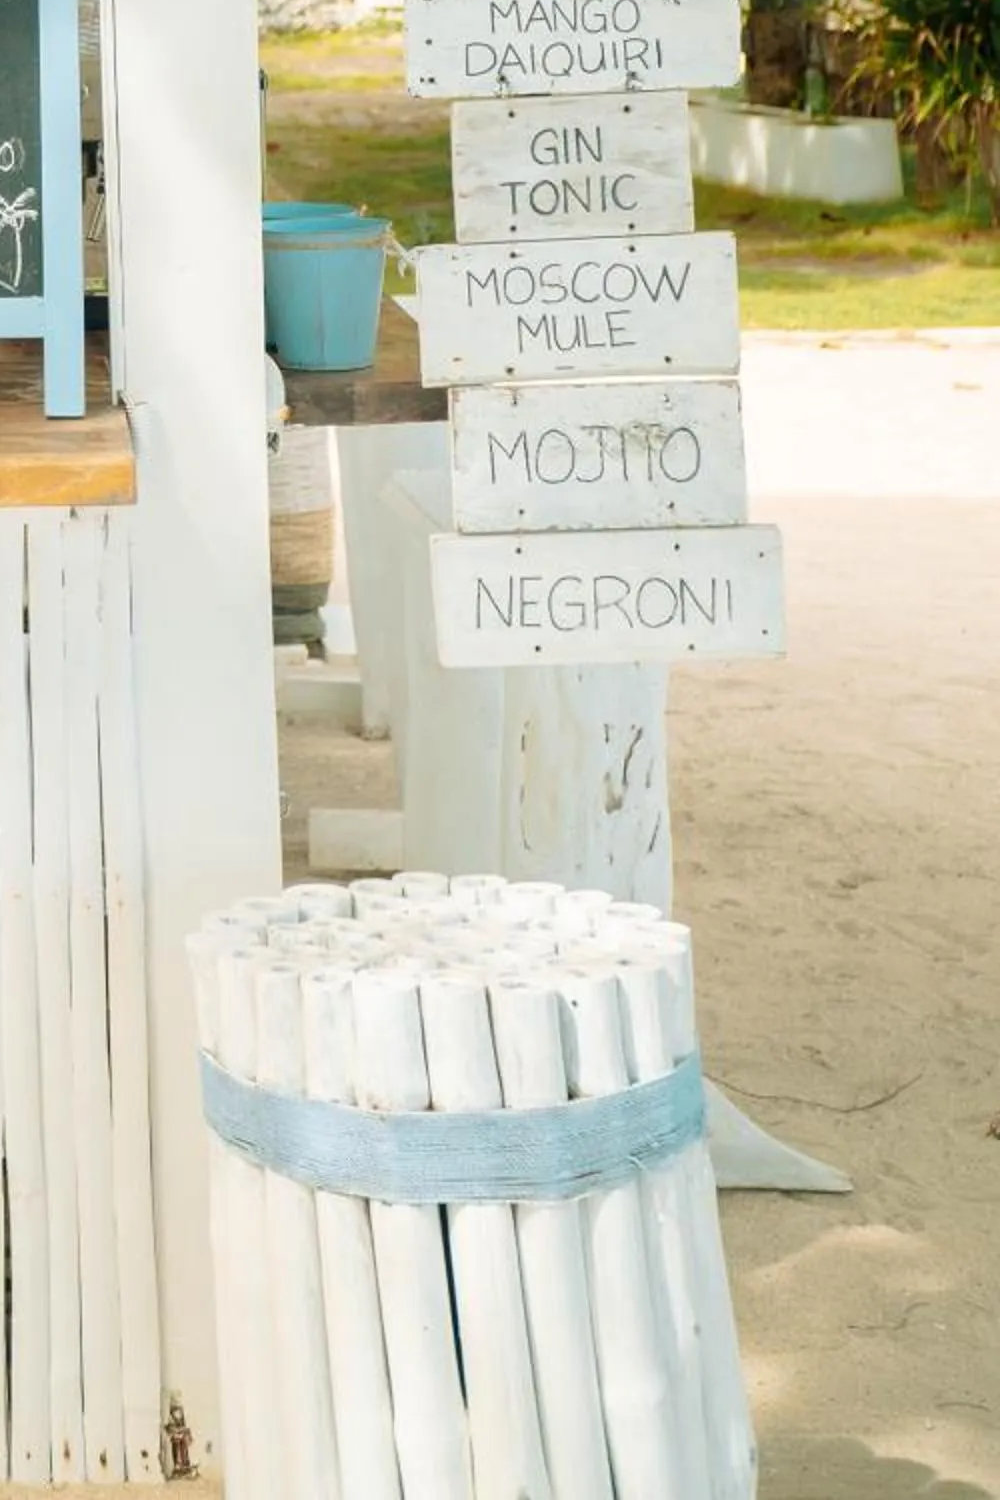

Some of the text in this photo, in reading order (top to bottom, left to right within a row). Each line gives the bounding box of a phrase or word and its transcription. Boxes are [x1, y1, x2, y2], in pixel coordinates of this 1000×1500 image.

[464, 38, 664, 77] DAIQUIRI
[530, 126, 603, 166] GIN
[501, 173, 638, 216] TONIC
[465, 261, 692, 307] MOSCOW
[516, 310, 637, 353] MULE
[487, 423, 701, 485] MOJITO
[474, 574, 734, 631] NEGRONI
